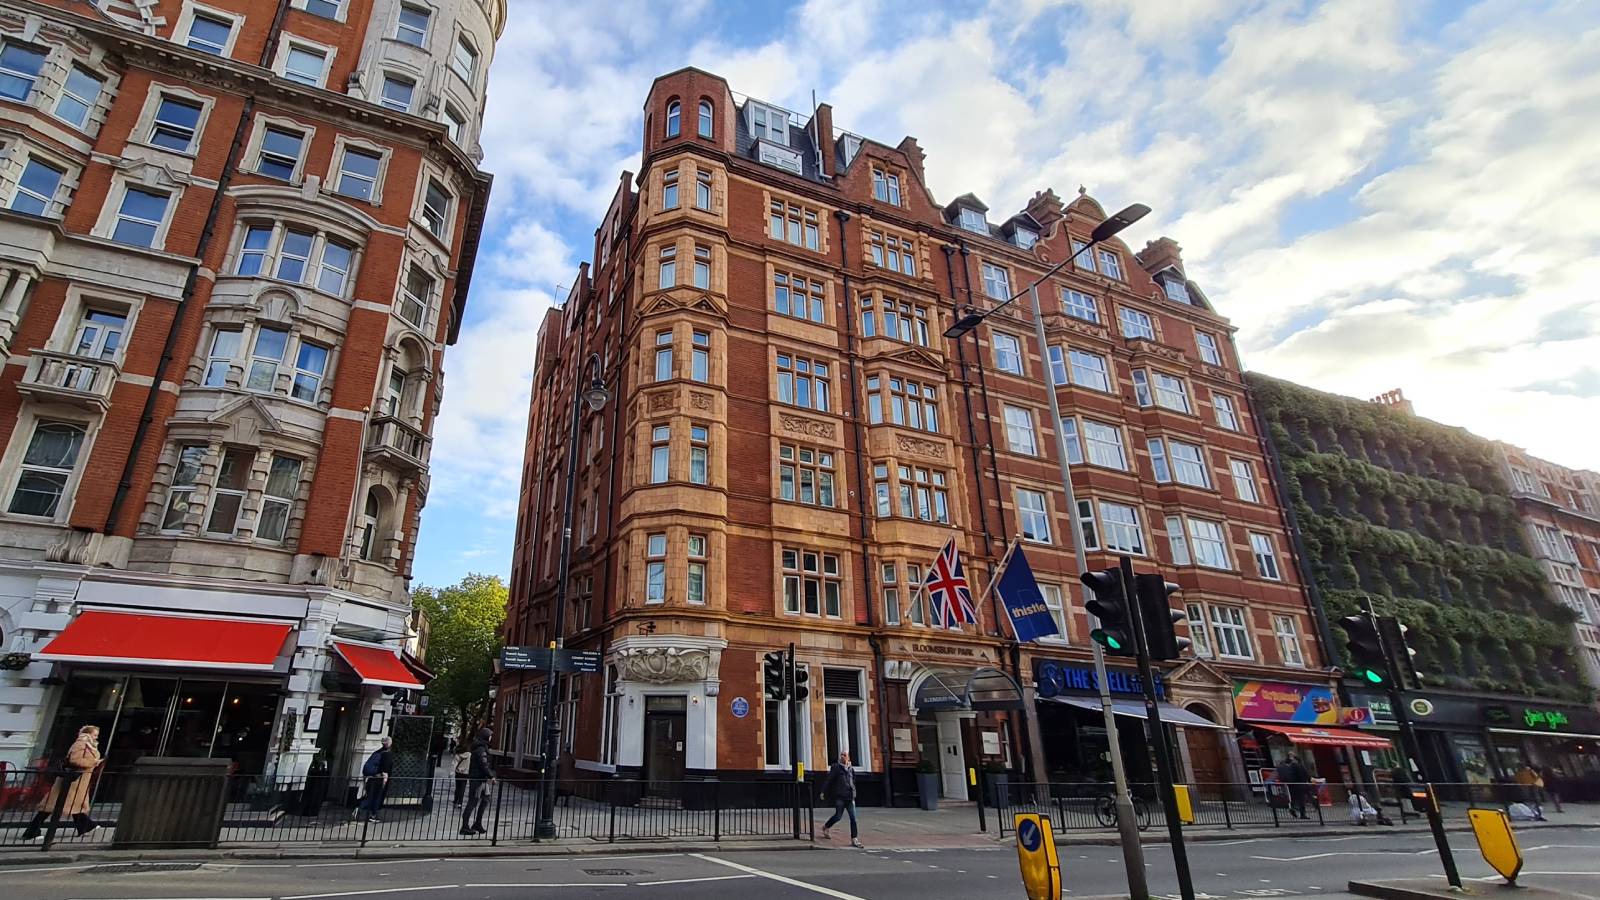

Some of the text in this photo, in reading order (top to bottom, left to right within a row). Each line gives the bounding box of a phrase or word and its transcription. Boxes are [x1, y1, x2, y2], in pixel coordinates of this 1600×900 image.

[1012, 603, 1046, 618] thistle
[912, 643, 974, 657] BLOOMSBURY PARK
[1062, 667, 1091, 689] THE
[1091, 670, 1132, 693] SELL
